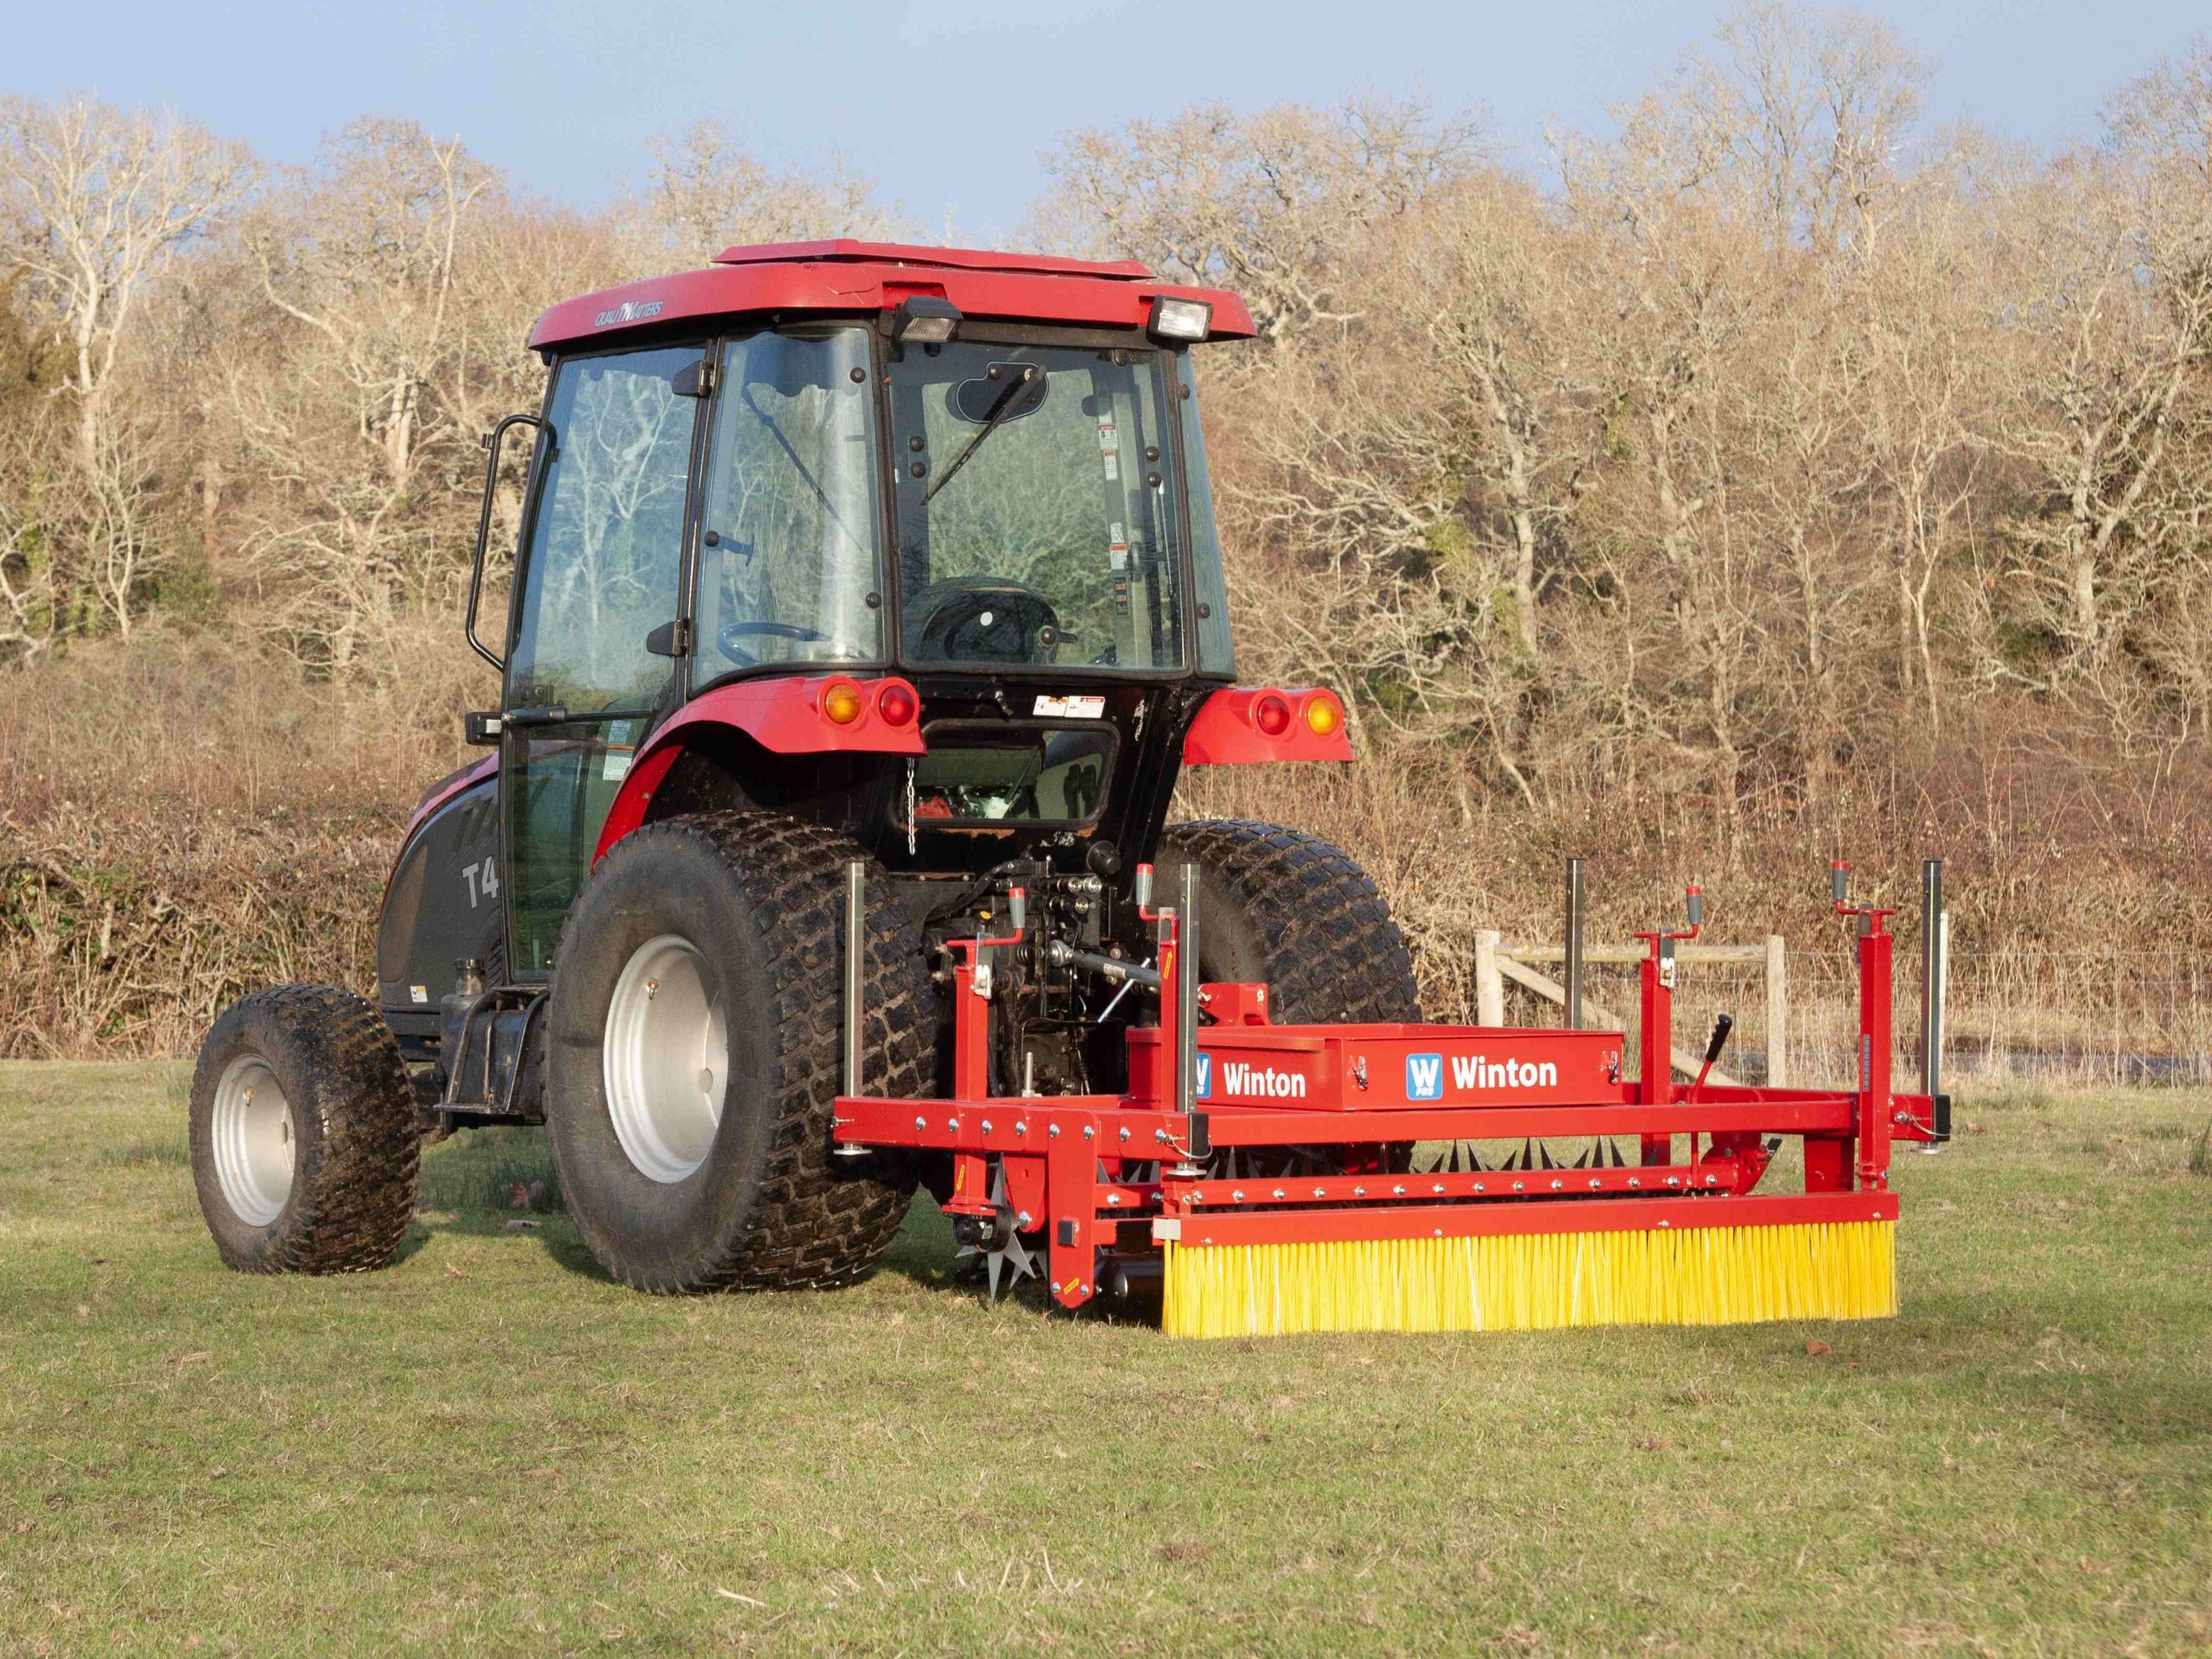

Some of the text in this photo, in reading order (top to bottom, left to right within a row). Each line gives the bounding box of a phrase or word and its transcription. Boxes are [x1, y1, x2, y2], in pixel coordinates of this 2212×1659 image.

[1224, 1063, 1306, 1097] Winton
[1409, 1058, 1440, 1087] W
[1452, 1055, 1557, 1090] Winton
[1415, 1086, 1434, 1096] PRO
